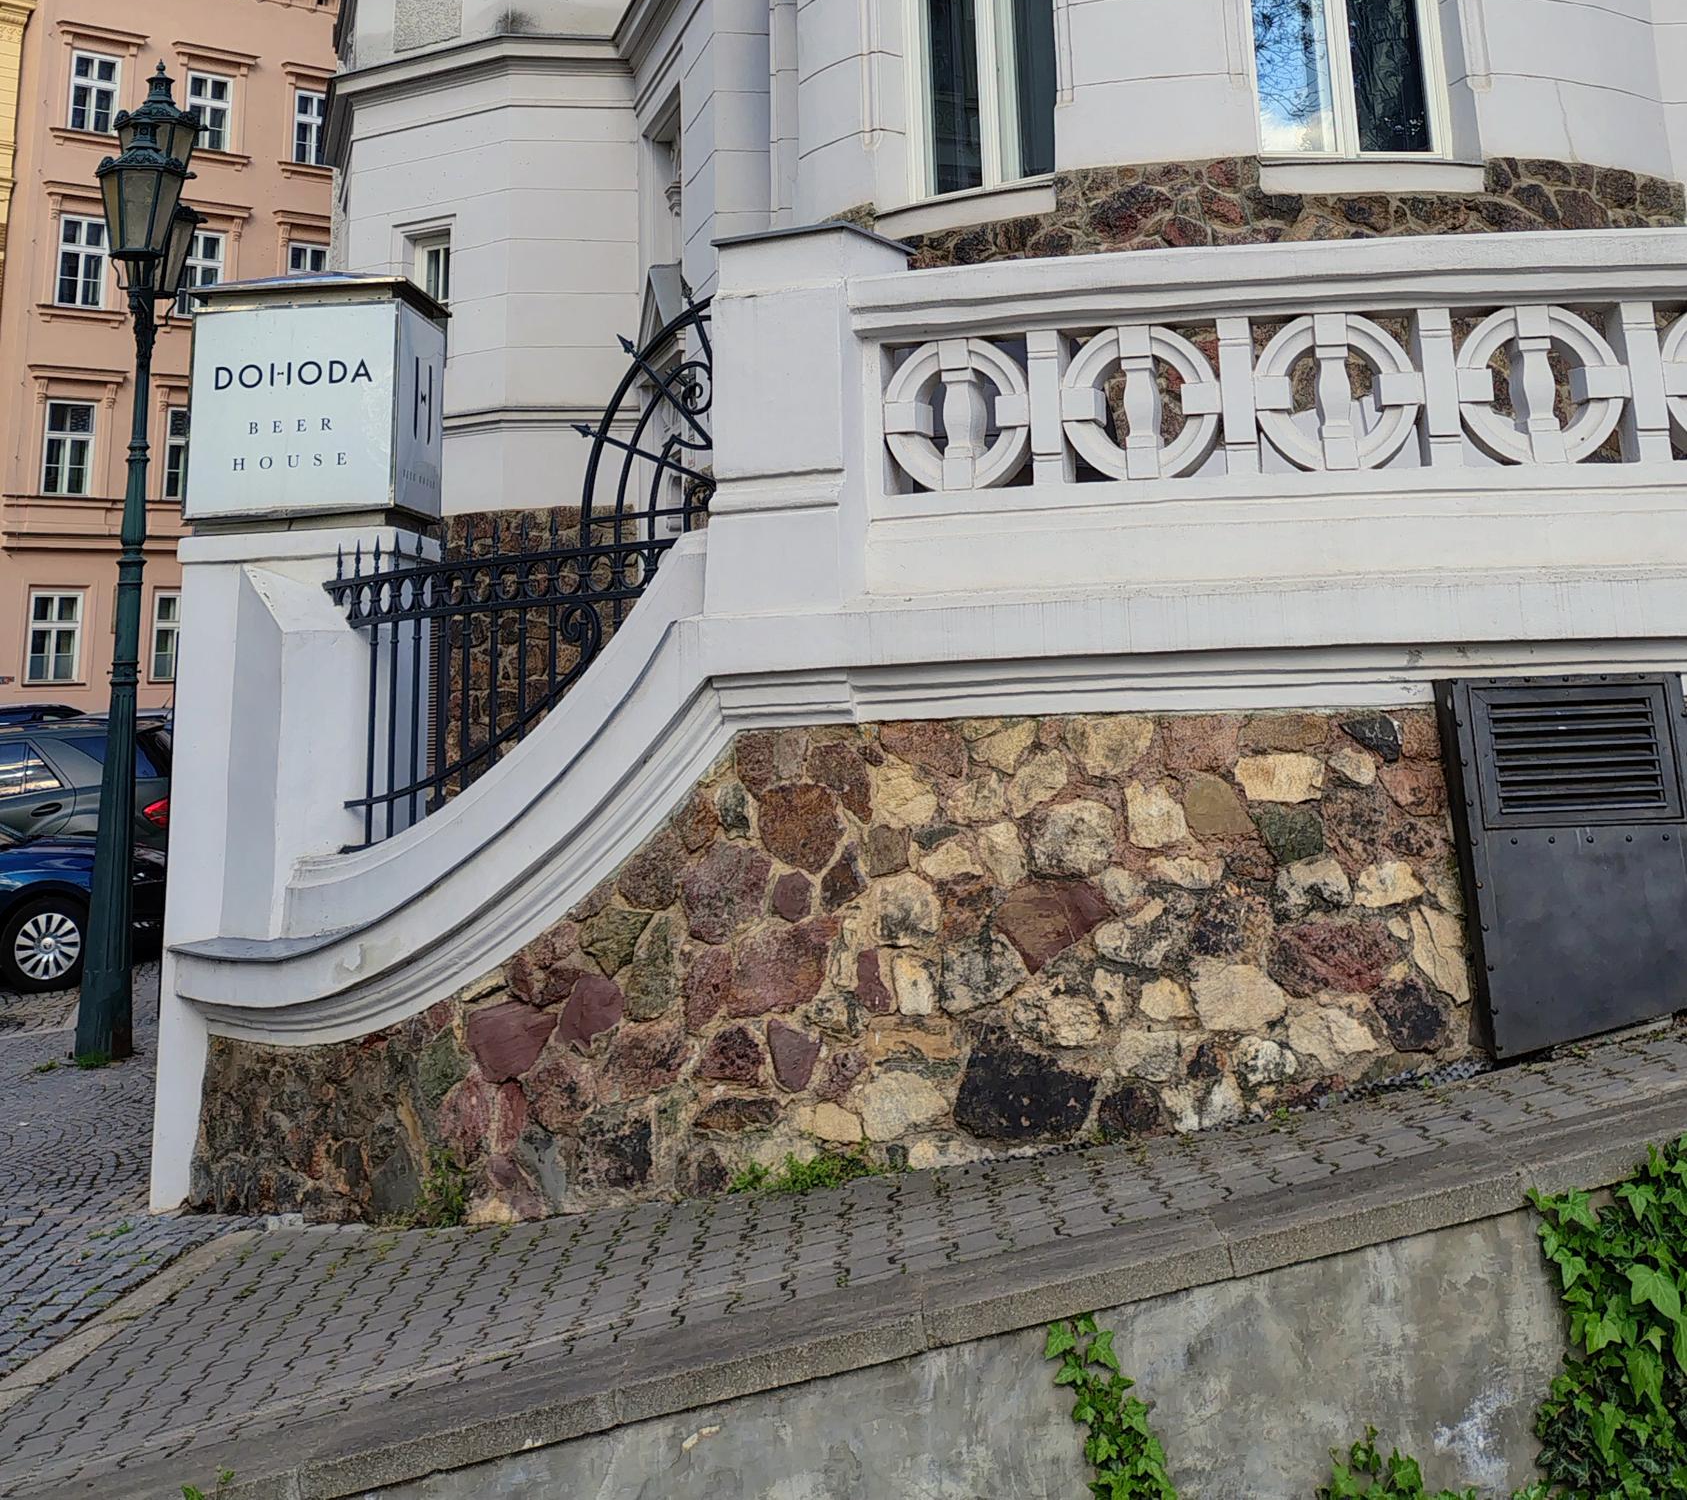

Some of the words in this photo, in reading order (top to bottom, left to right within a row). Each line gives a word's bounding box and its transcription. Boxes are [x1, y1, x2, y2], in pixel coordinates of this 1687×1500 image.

[214, 359, 373, 390] DOHODA
[248, 418, 333, 435] BEER
[232, 452, 347, 471] HOUSE
